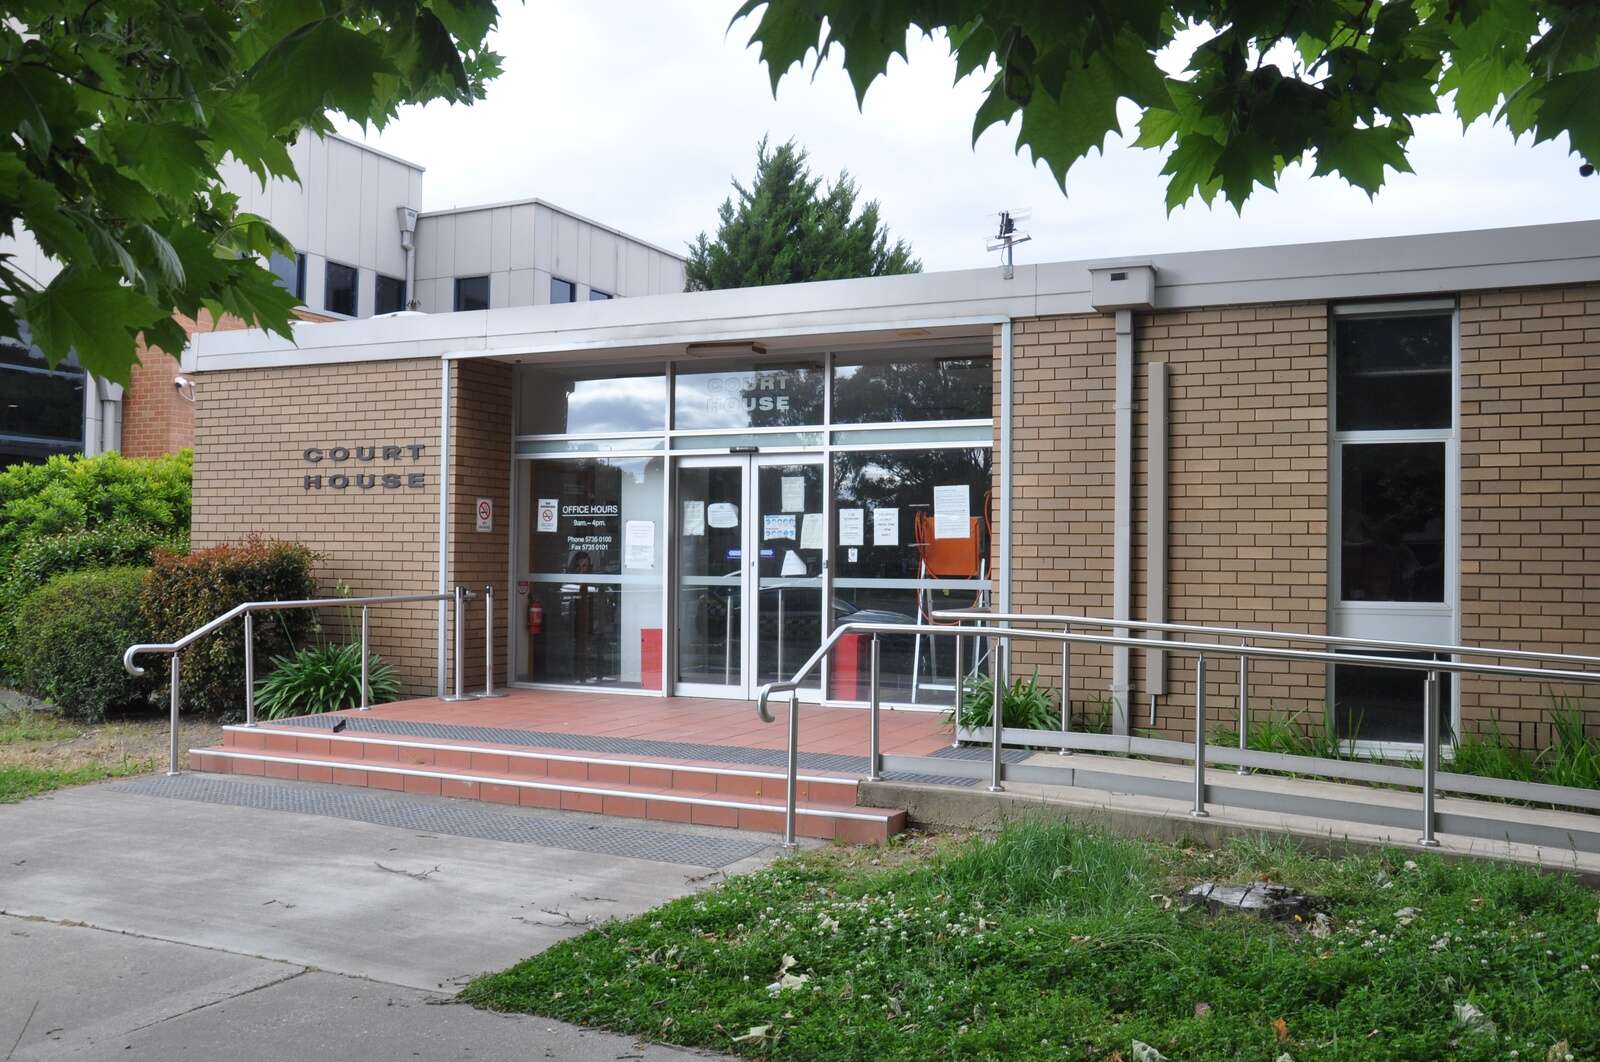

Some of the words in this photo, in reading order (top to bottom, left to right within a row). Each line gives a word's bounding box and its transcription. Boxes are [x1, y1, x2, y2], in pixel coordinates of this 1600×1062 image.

[706, 376, 789, 393] COURT
[706, 396, 789, 412] HOUSE
[303, 445, 425, 463] COURT
[303, 473, 425, 490] HOUSE
[562, 505, 589, 514] OFFICE
[590, 505, 618, 514] HOURS
[567, 535, 585, 543] Phone
[585, 535, 599, 543] 5735
[599, 535, 612, 543] 0100
[581, 543, 595, 551] 5735
[595, 543, 608, 551] 0101
